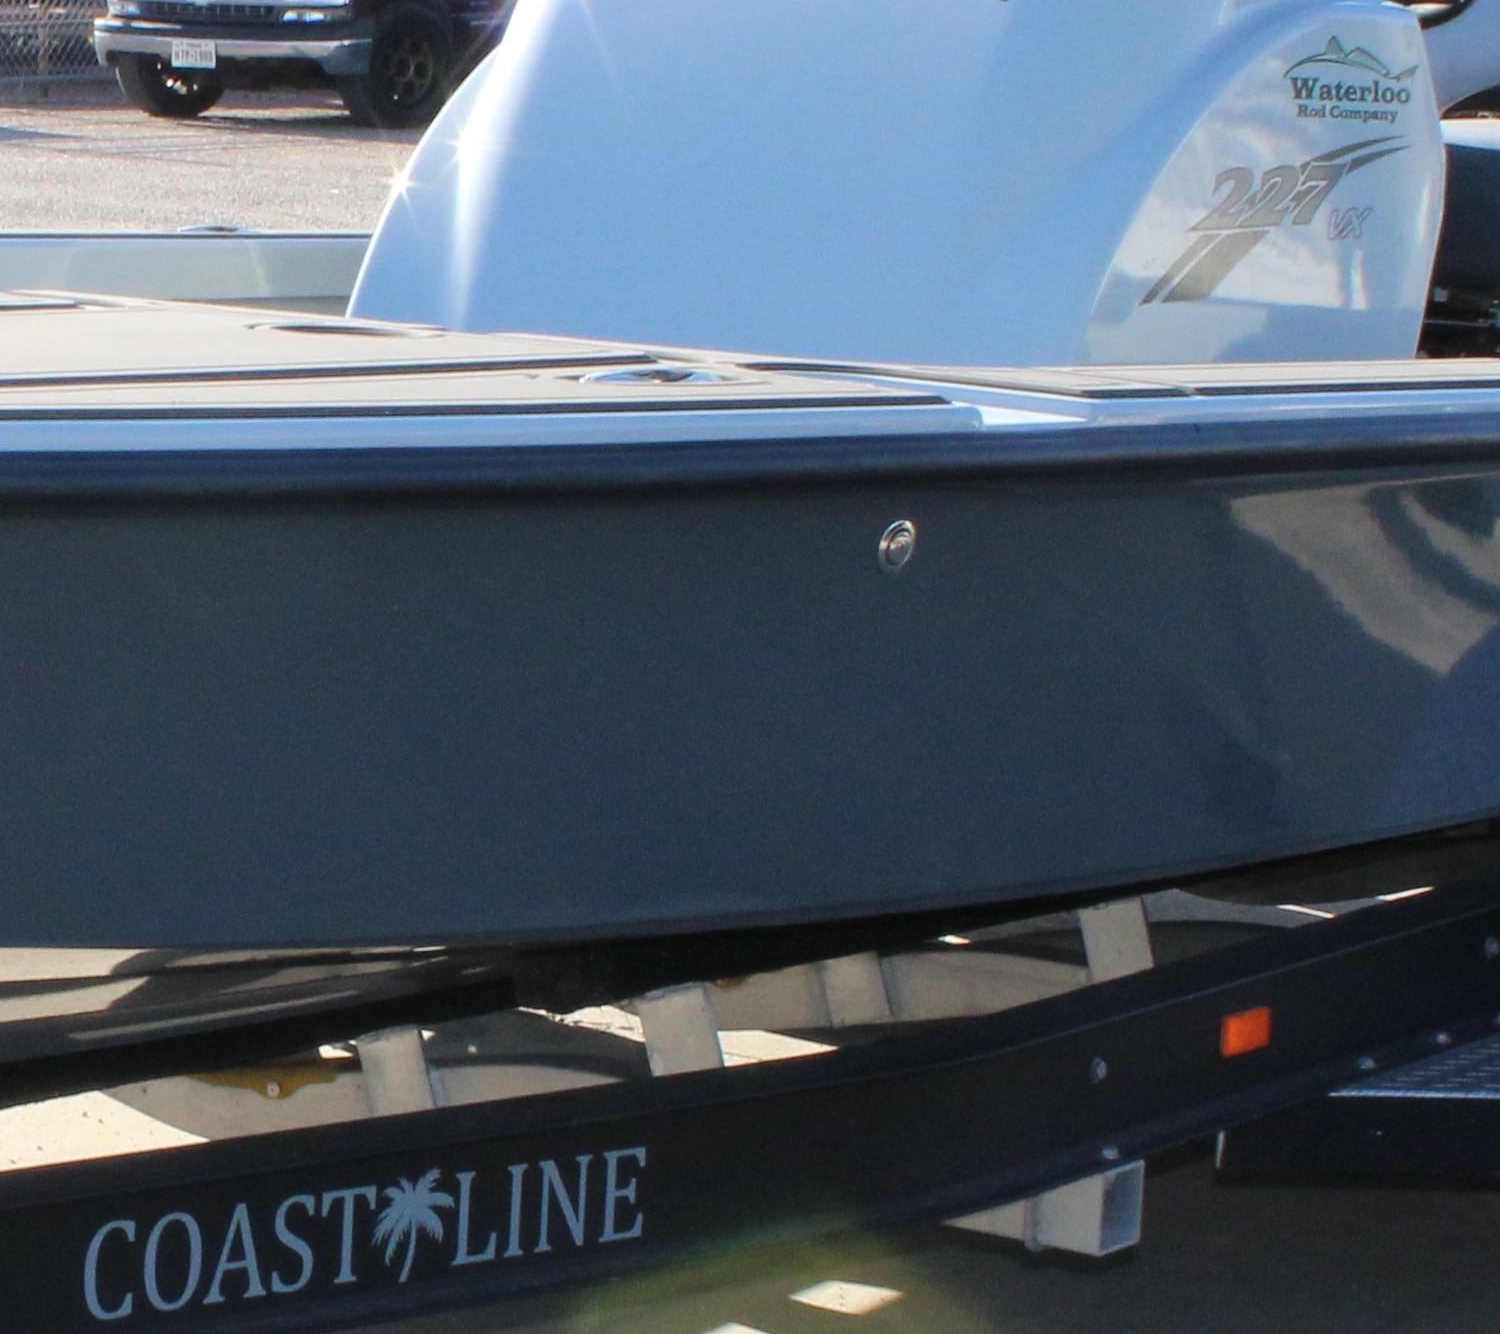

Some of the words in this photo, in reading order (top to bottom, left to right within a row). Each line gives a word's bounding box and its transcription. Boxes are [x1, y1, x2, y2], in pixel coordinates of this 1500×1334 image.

[1289, 77, 1410, 104] Waterloo
[1296, 104, 1326, 118] Rod
[1329, 105, 1399, 124] Company
[1187, 162, 1350, 232] 227
[1327, 207, 1372, 240] VX
[450, 1146, 648, 1267] LINE
